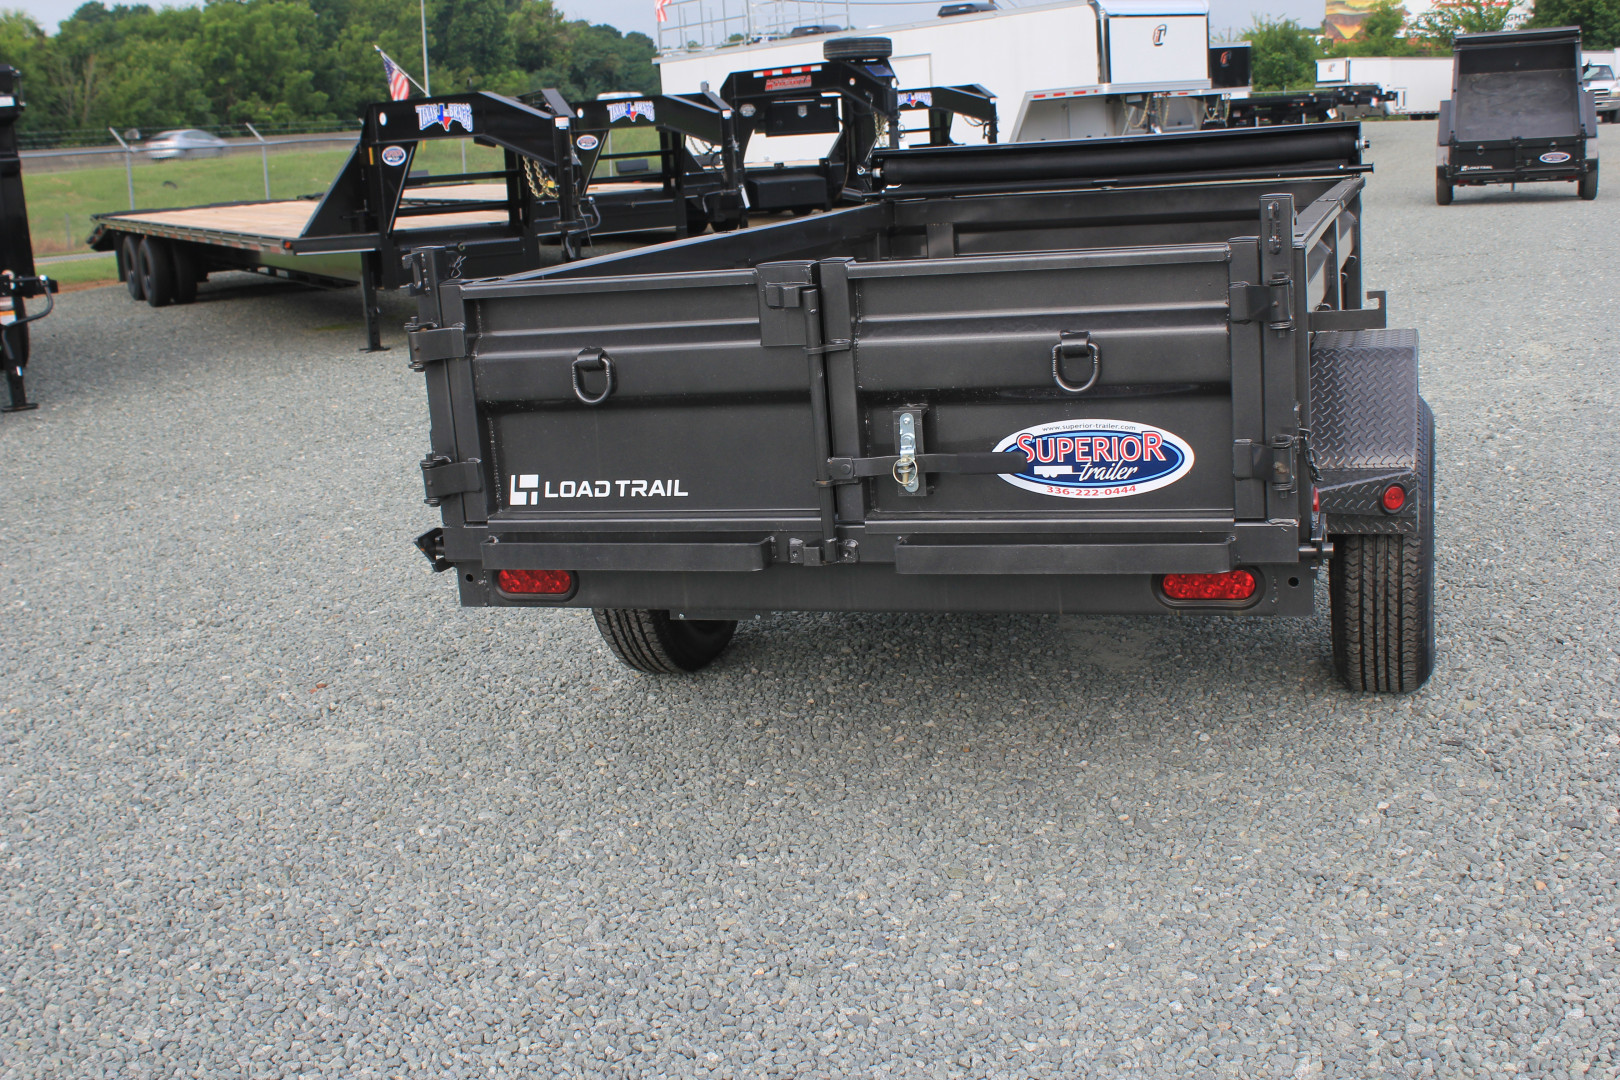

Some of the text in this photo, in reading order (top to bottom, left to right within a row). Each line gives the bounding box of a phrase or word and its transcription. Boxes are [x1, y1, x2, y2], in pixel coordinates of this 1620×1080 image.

[1041, 422, 1136, 432] www.superior-trailer.com
[1017, 431, 1167, 463] SUPERIOR
[1079, 459, 1139, 481] trailer
[545, 479, 689, 498] LOAD TRAIL
[1046, 485, 1137, 497] 336-222-0444
